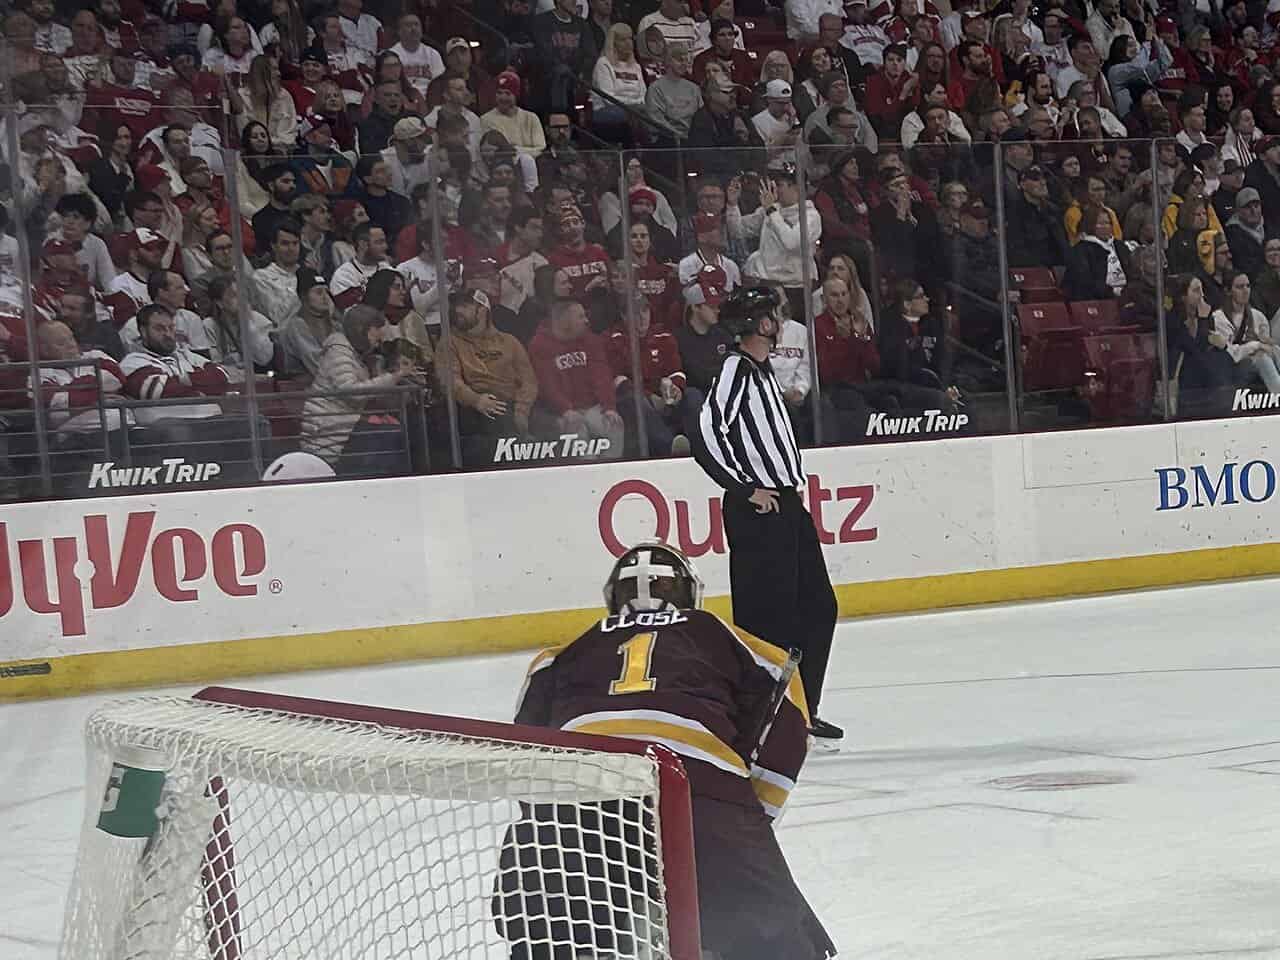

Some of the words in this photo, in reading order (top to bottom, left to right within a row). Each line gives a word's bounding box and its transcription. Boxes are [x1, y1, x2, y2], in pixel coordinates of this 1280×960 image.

[1154, 459, 1276, 511] BMO
[598, 474, 878, 558] Qutz
[602, 608, 688, 632] CLOSE
[608, 631, 658, 697] 1
